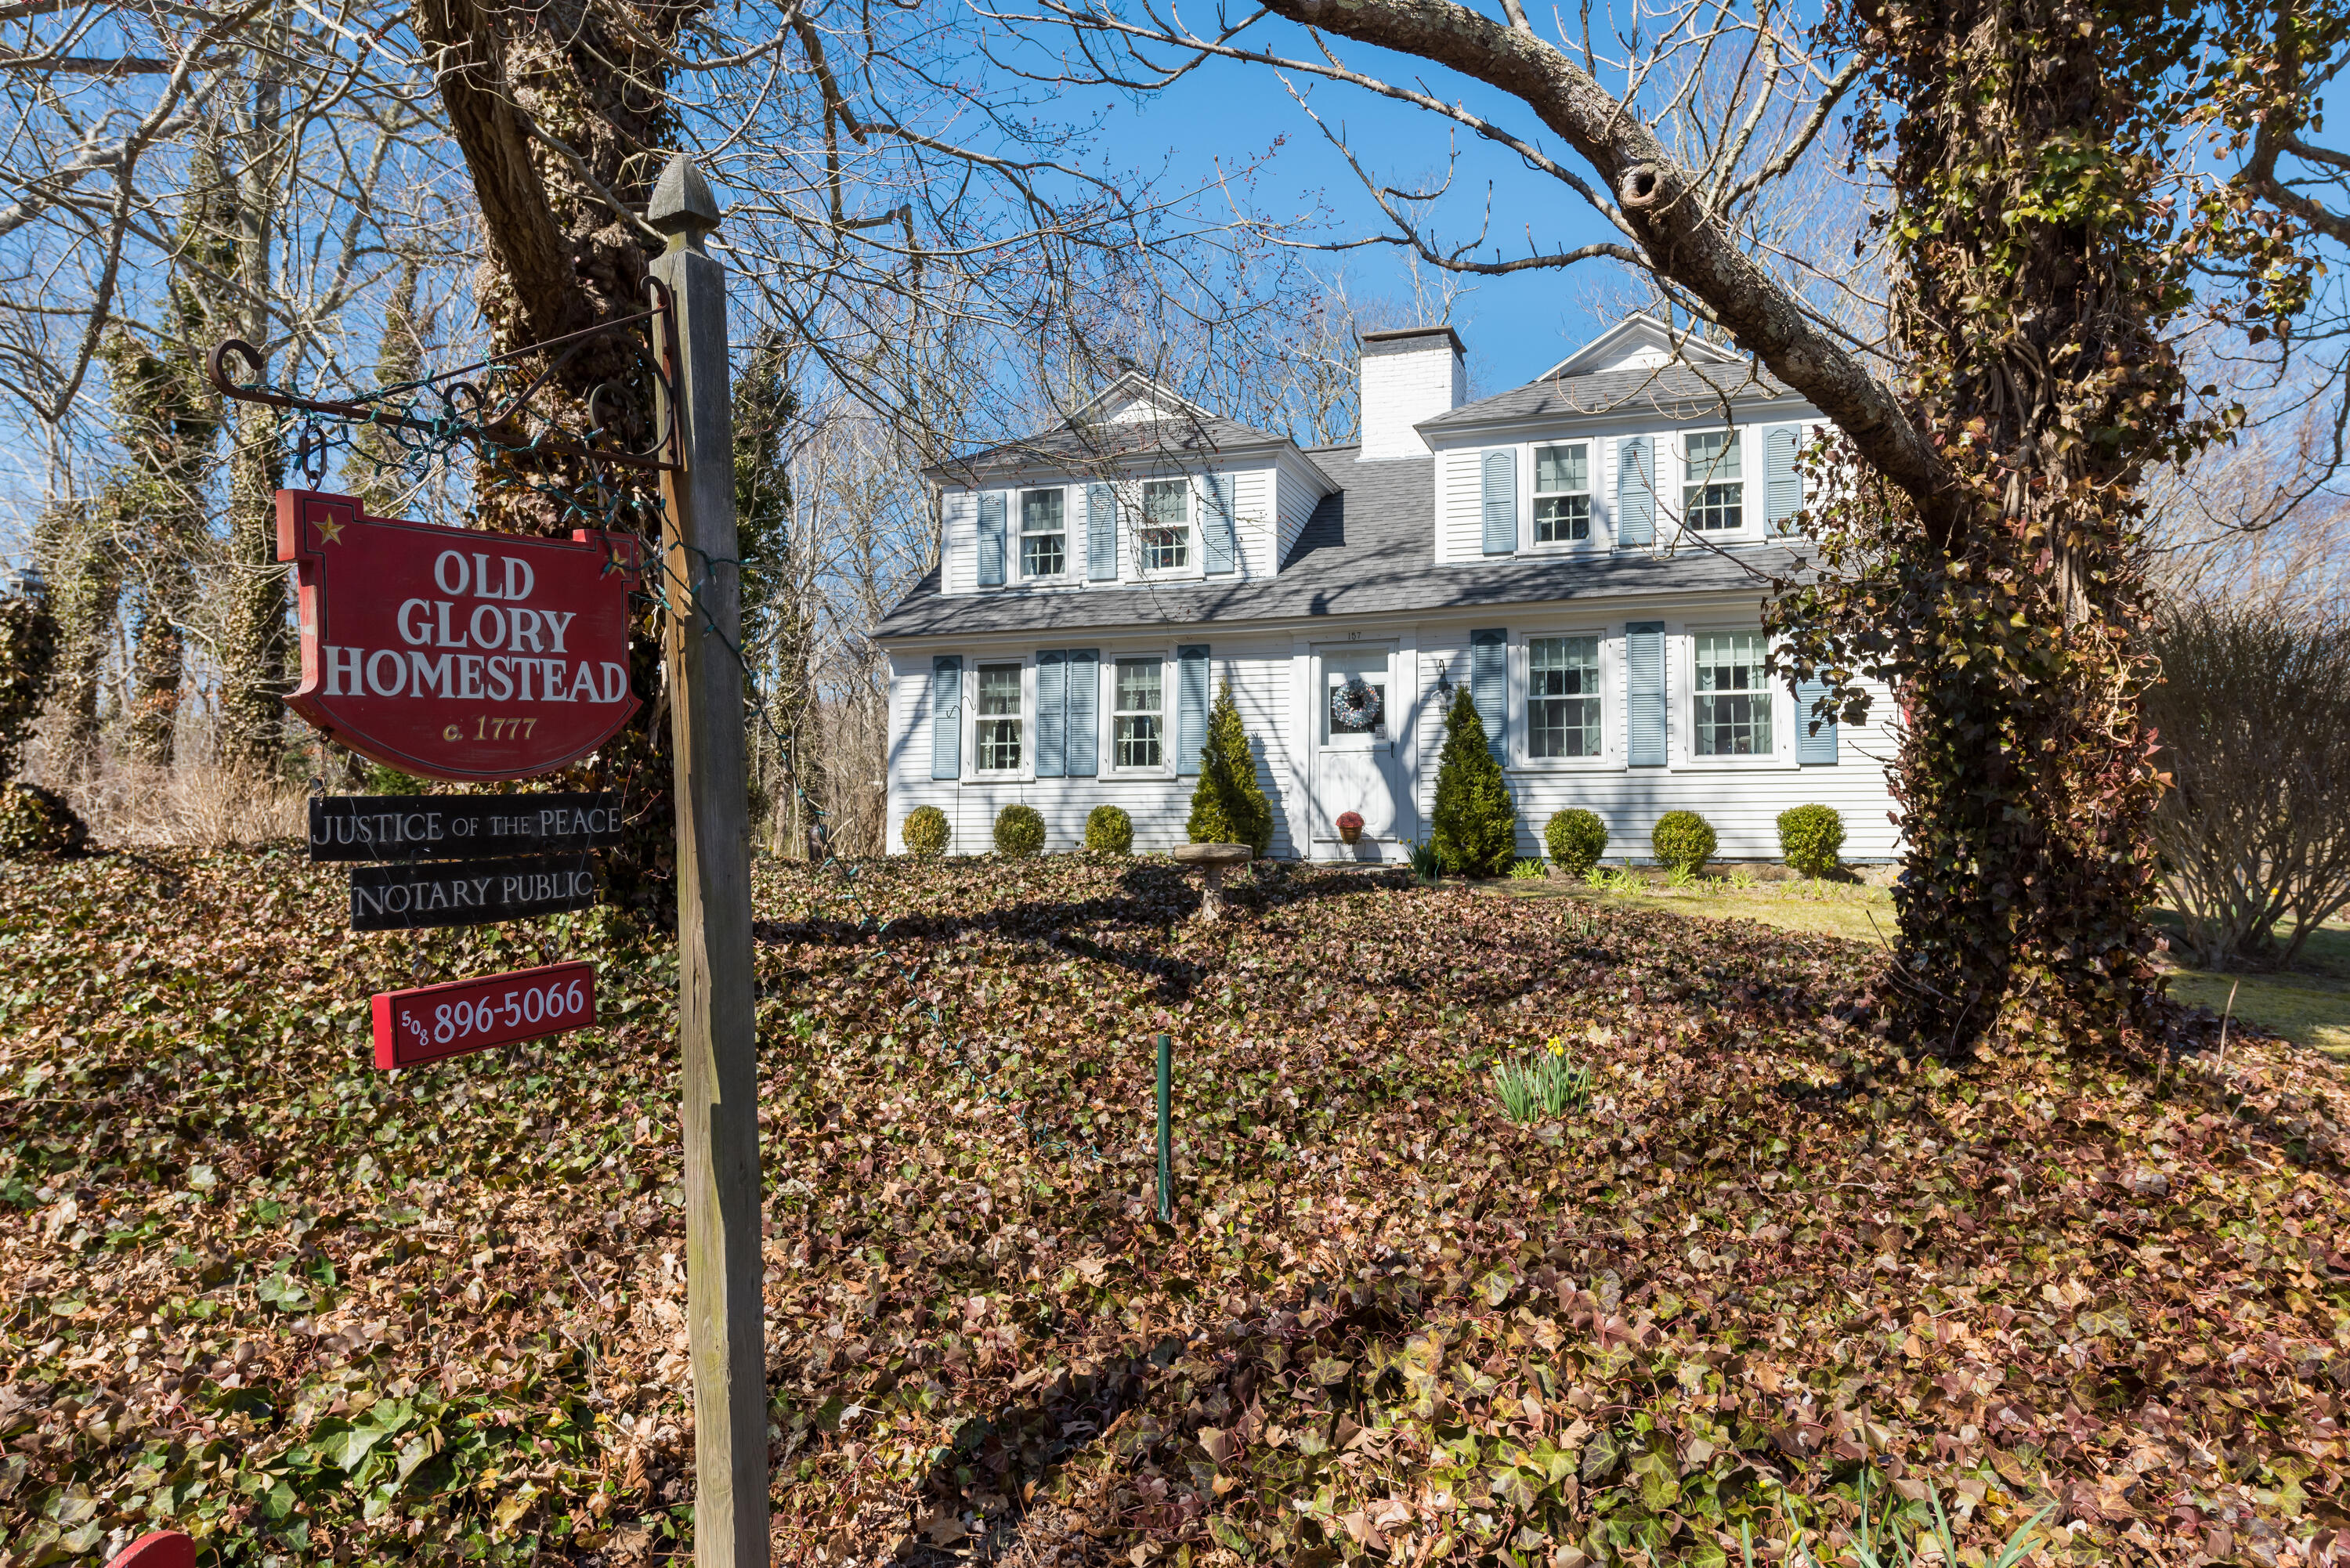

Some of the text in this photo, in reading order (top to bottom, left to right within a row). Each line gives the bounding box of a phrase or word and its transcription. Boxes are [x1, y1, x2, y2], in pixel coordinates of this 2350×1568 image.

[435, 550, 534, 601] OLD
[397, 598, 577, 653] GLORY
[1347, 631, 1361, 641] 157
[323, 645, 627, 703] HOMESTEAD
[473, 715, 538, 740] 1777
[313, 807, 621, 845] JUSTICE OF THE PEACE
[354, 871, 593, 916] NOTARY PUBLIC
[401, 979, 584, 1046] 508 896-5066
